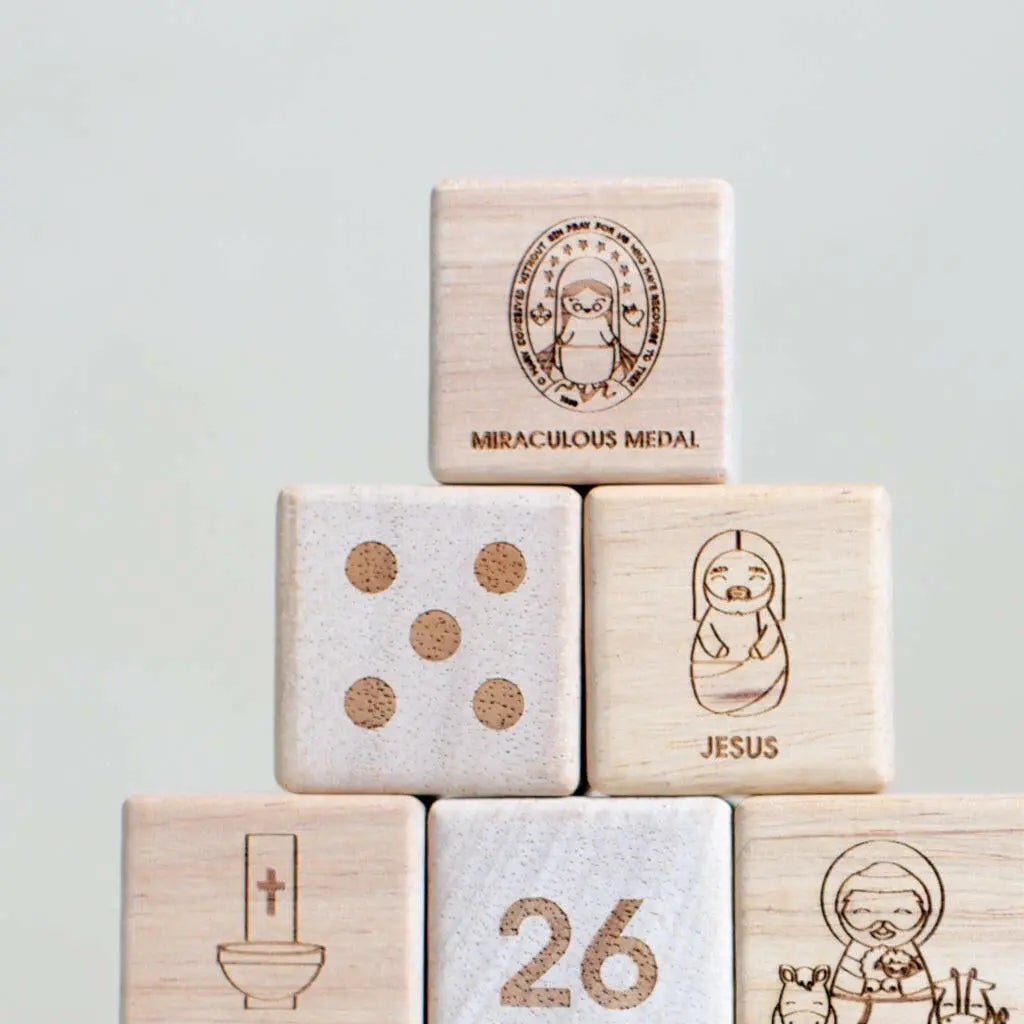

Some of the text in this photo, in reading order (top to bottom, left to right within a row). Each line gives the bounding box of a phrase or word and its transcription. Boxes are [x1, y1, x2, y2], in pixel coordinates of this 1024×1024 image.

[471, 430, 701, 450] MIRACULOUS MEDAL
[700, 735, 779, 760] JESUS
[498, 896, 659, 1011] 26
